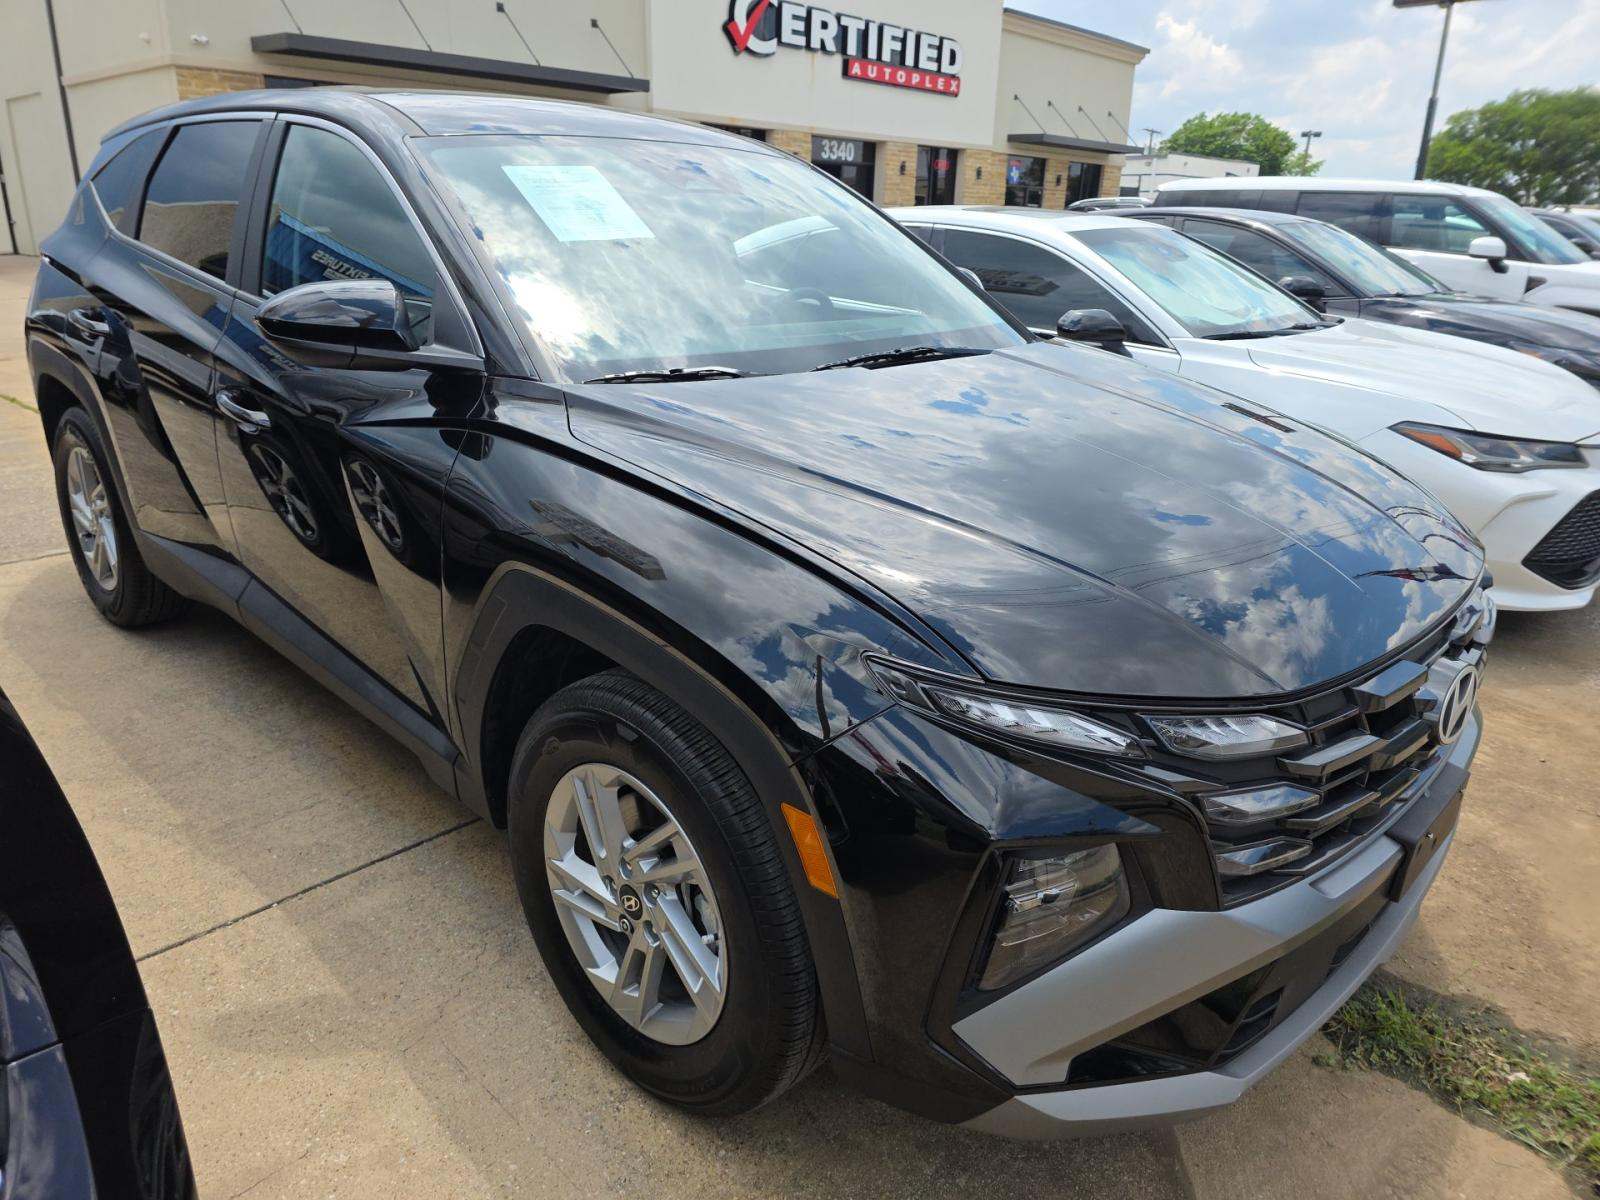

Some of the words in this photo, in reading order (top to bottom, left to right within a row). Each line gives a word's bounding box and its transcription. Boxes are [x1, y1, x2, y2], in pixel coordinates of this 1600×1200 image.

[730, 0, 963, 76] CERTIFIED
[851, 61, 959, 93] AUTOPLEX
[820, 138, 855, 162] 3340
